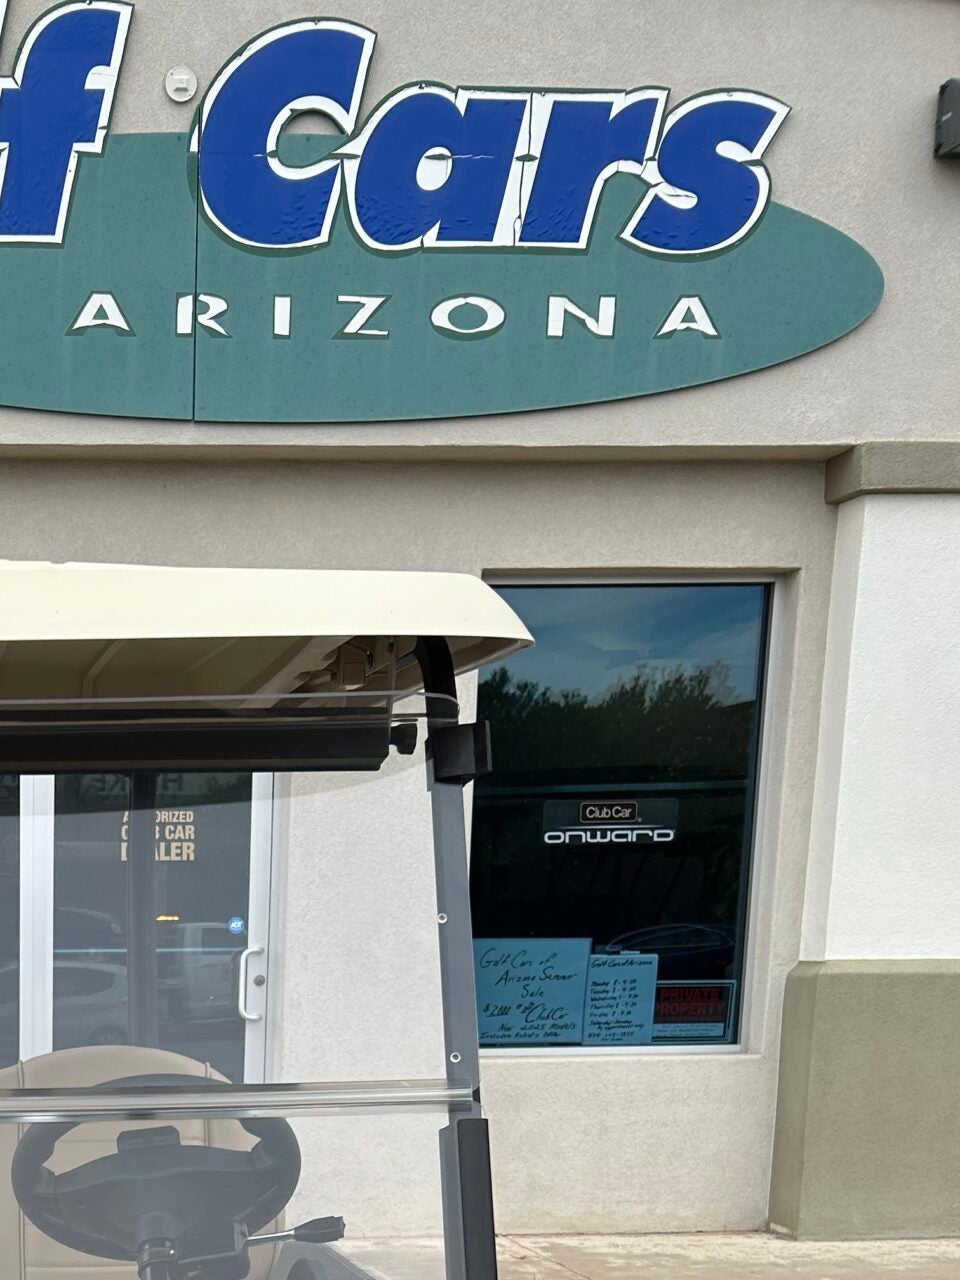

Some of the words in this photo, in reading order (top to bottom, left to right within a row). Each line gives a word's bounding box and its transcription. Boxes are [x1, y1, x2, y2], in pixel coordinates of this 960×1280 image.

[192, 18, 790, 255] Cars
[72, 292, 719, 337] ARIZONA
[123, 811, 194, 823] ARIZED
[586, 806, 611, 818] Club
[612, 806, 632, 818] Car
[165, 825, 195, 840] CAR
[661, 988, 720, 1001] PRIVATE
